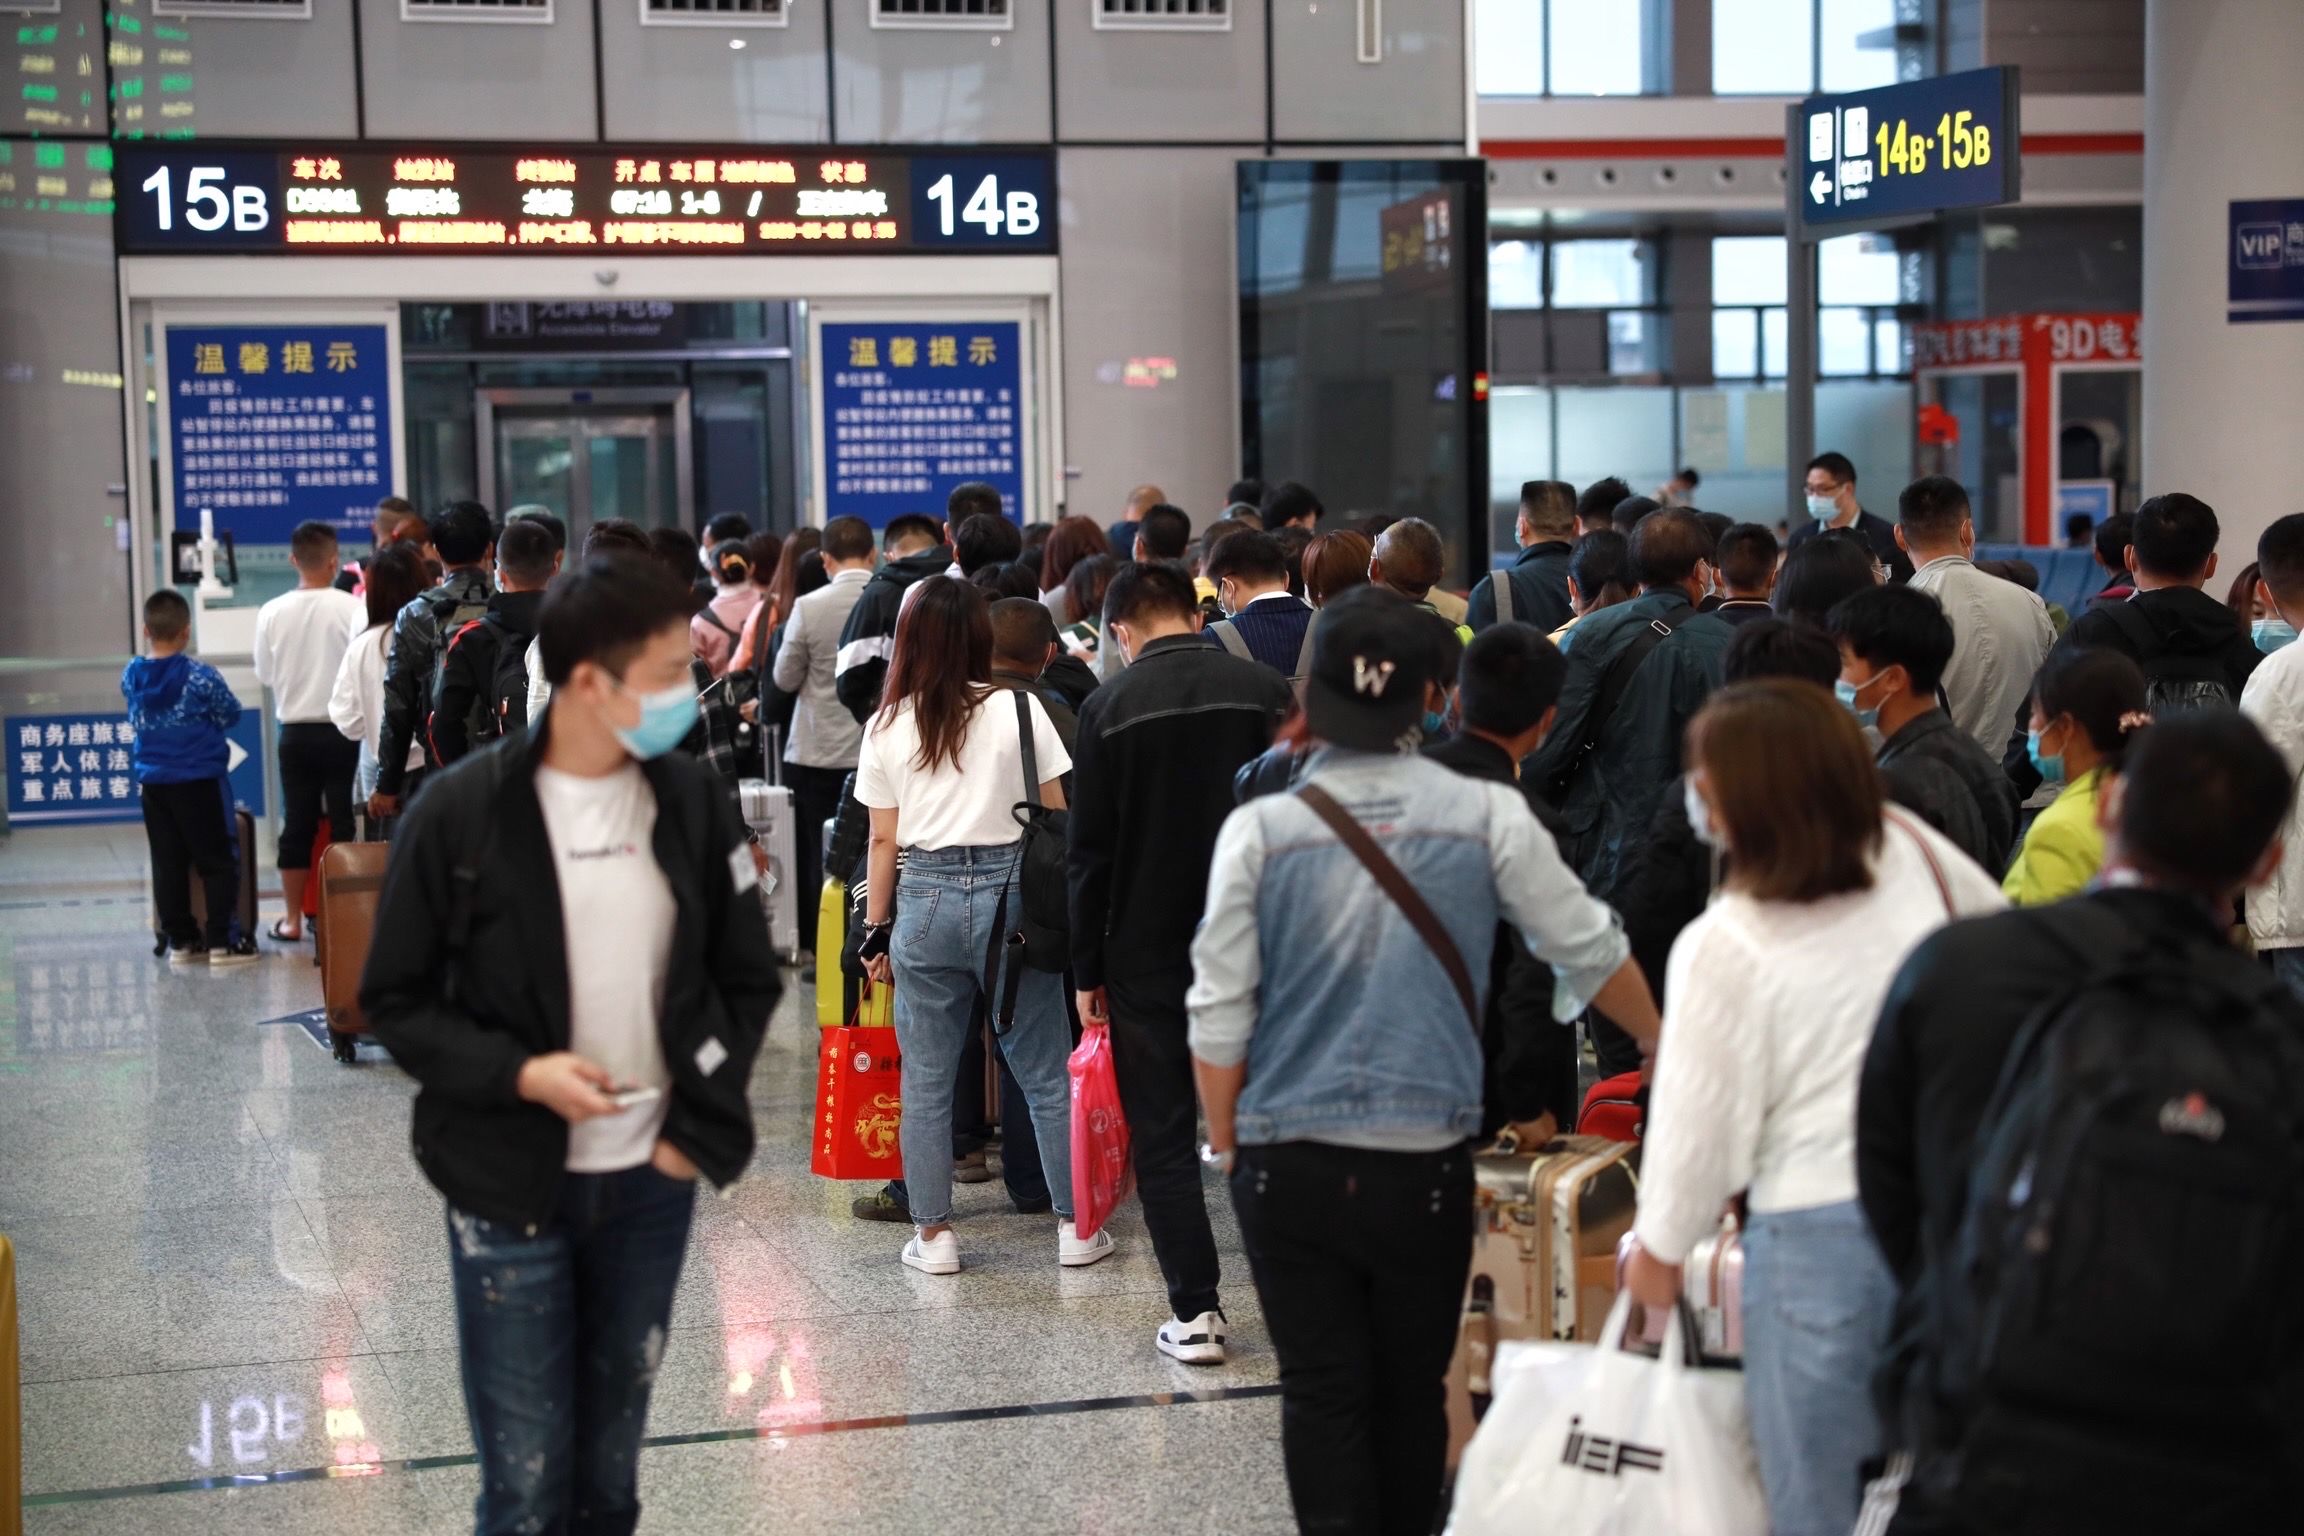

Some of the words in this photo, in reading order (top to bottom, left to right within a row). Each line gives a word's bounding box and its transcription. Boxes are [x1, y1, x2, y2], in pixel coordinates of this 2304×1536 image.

[291, 156, 342, 181] 车次
[615, 159, 661, 183] 开点
[142, 165, 271, 233] 15B
[926, 173, 1041, 237] 14B
[2241, 235, 2280, 257] VIP
[194, 340, 357, 374] 温馨提示
[849, 336, 997, 367] 温馨提示
[1353, 655, 1396, 698] W
[20, 722, 136, 748] 商务座旅客
[21, 749, 130, 775] 军人依法
[23, 776, 142, 803] 重点旅客
